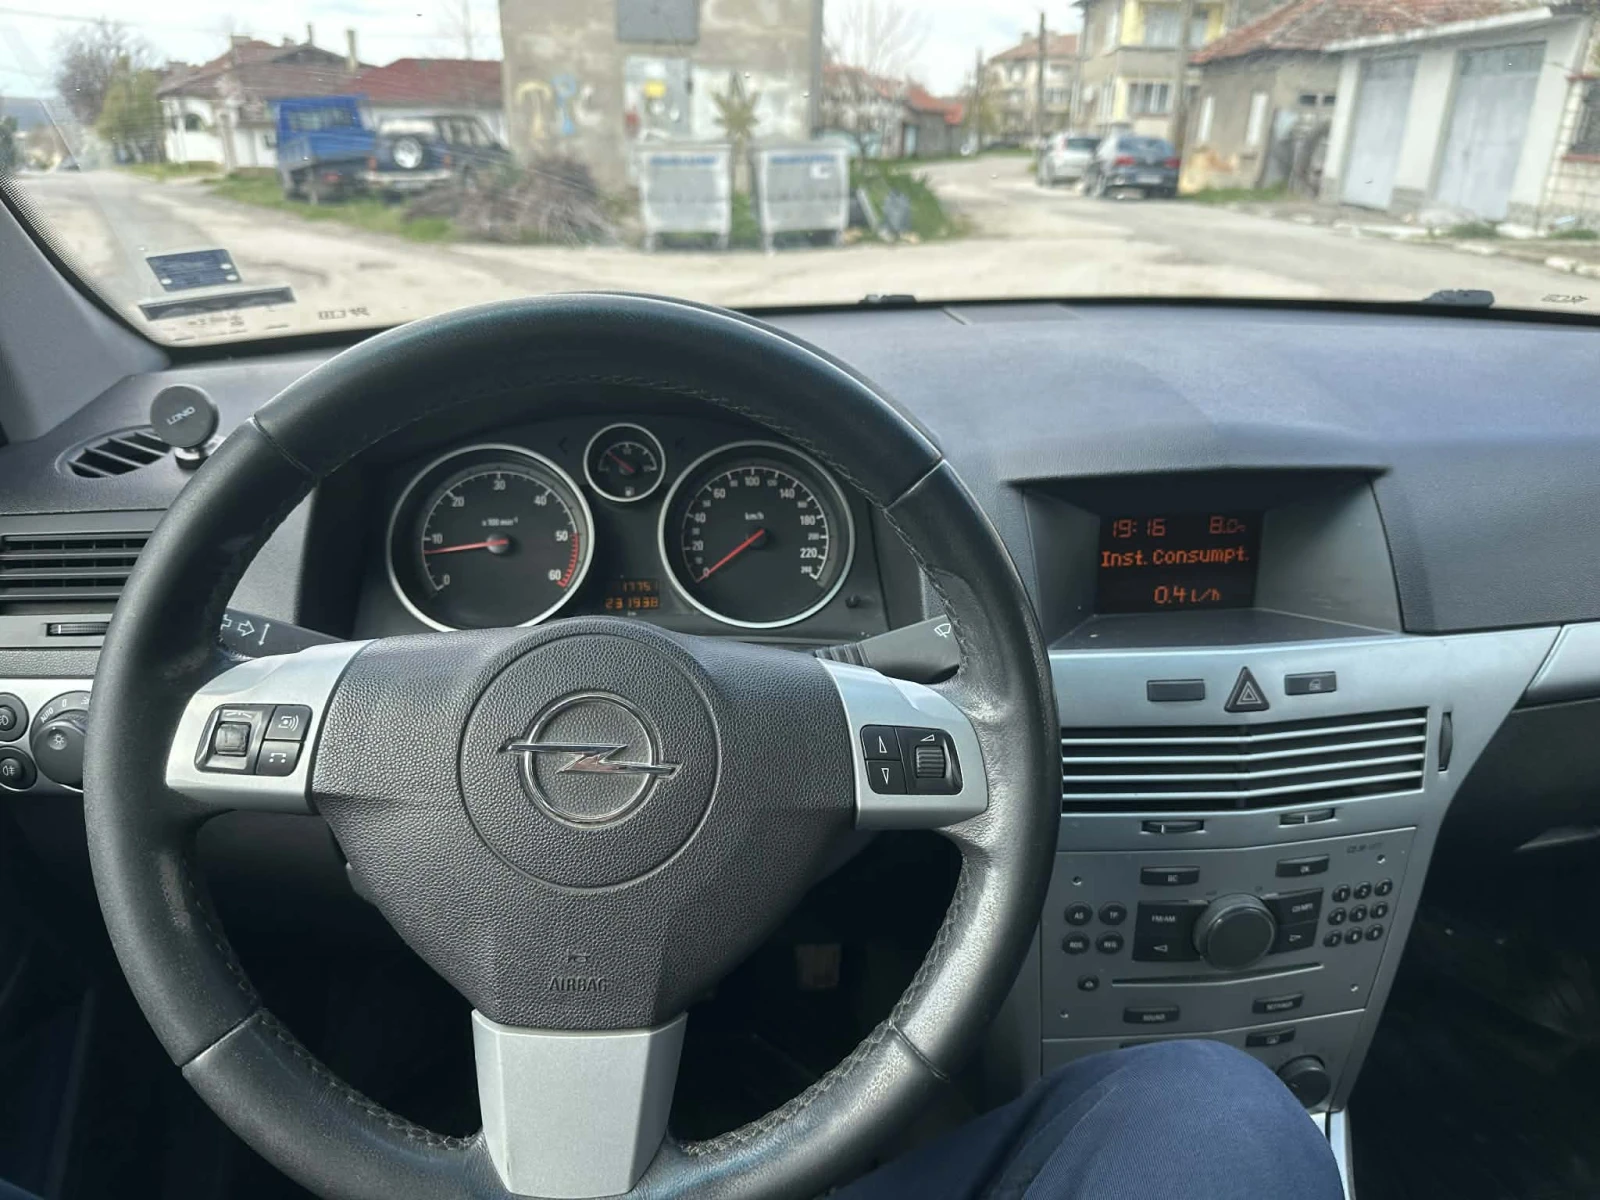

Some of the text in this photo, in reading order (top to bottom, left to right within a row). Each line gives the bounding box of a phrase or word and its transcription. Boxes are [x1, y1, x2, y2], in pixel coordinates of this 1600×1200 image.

[493, 479, 506, 490] 30
[745, 476, 760, 486] 100
[713, 488, 726, 498] 60
[780, 488, 795, 499] 140
[452, 496, 465, 507] 20
[534, 495, 547, 506] 40
[694, 512, 706, 523] 40
[800, 515, 816, 526] 180
[431, 533, 443, 544] 10
[555, 530, 569, 541] 50
[692, 540, 704, 551] 20
[800, 547, 818, 559] 220
[1101, 546, 1250, 567] Inst. Consumpt.
[442, 574, 451, 586] 0
[548, 569, 562, 581] 60
[40, 707, 54, 723] AUTO
[549, 976, 607, 993] AIRBAG
